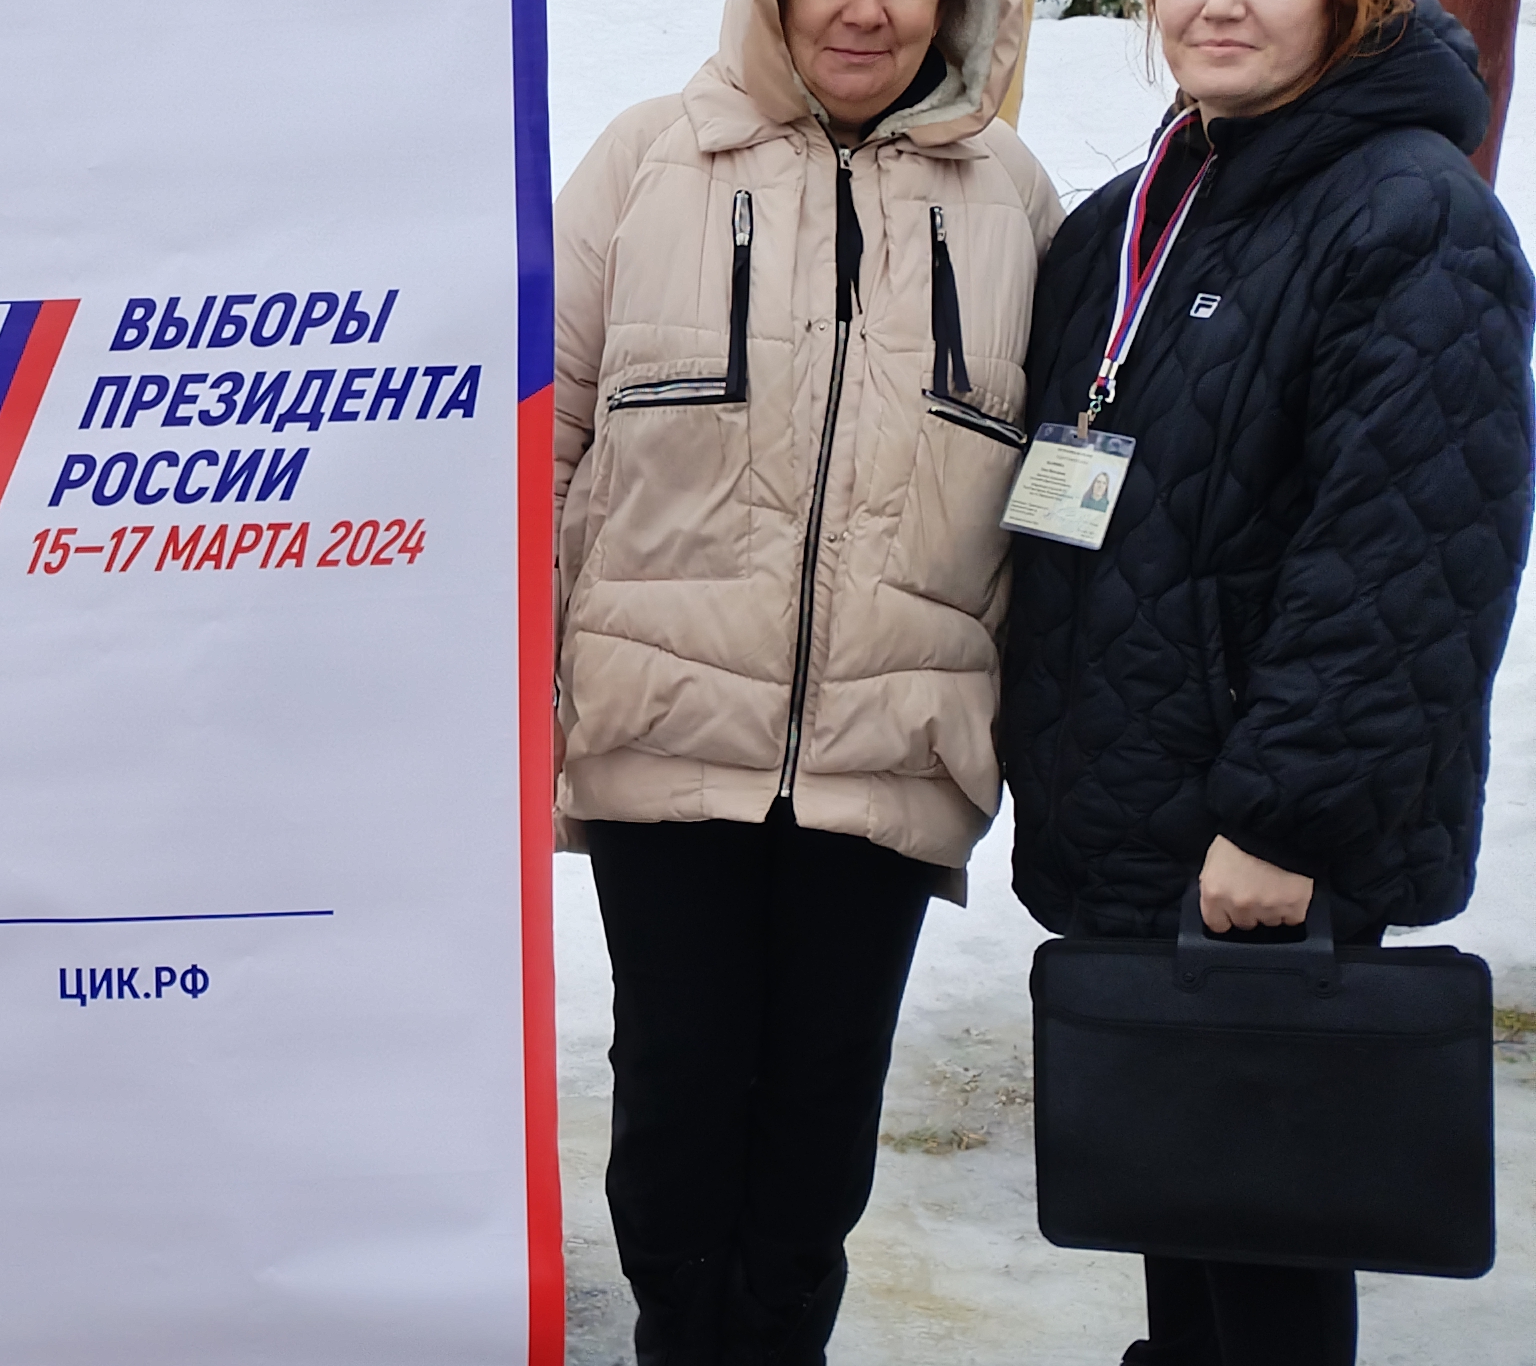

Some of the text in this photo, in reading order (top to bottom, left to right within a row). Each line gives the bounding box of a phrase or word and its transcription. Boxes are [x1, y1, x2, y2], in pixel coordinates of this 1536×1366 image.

[109, 289, 399, 351] ВЫБОРЫ
[79, 364, 482, 433] ПРЕЗИДЕНТА
[48, 447, 310, 507] РОССИИ
[155, 522, 310, 572] МАРТА
[316, 518, 426, 568] 2024
[59, 964, 211, 1008] ЦИК.РФ
